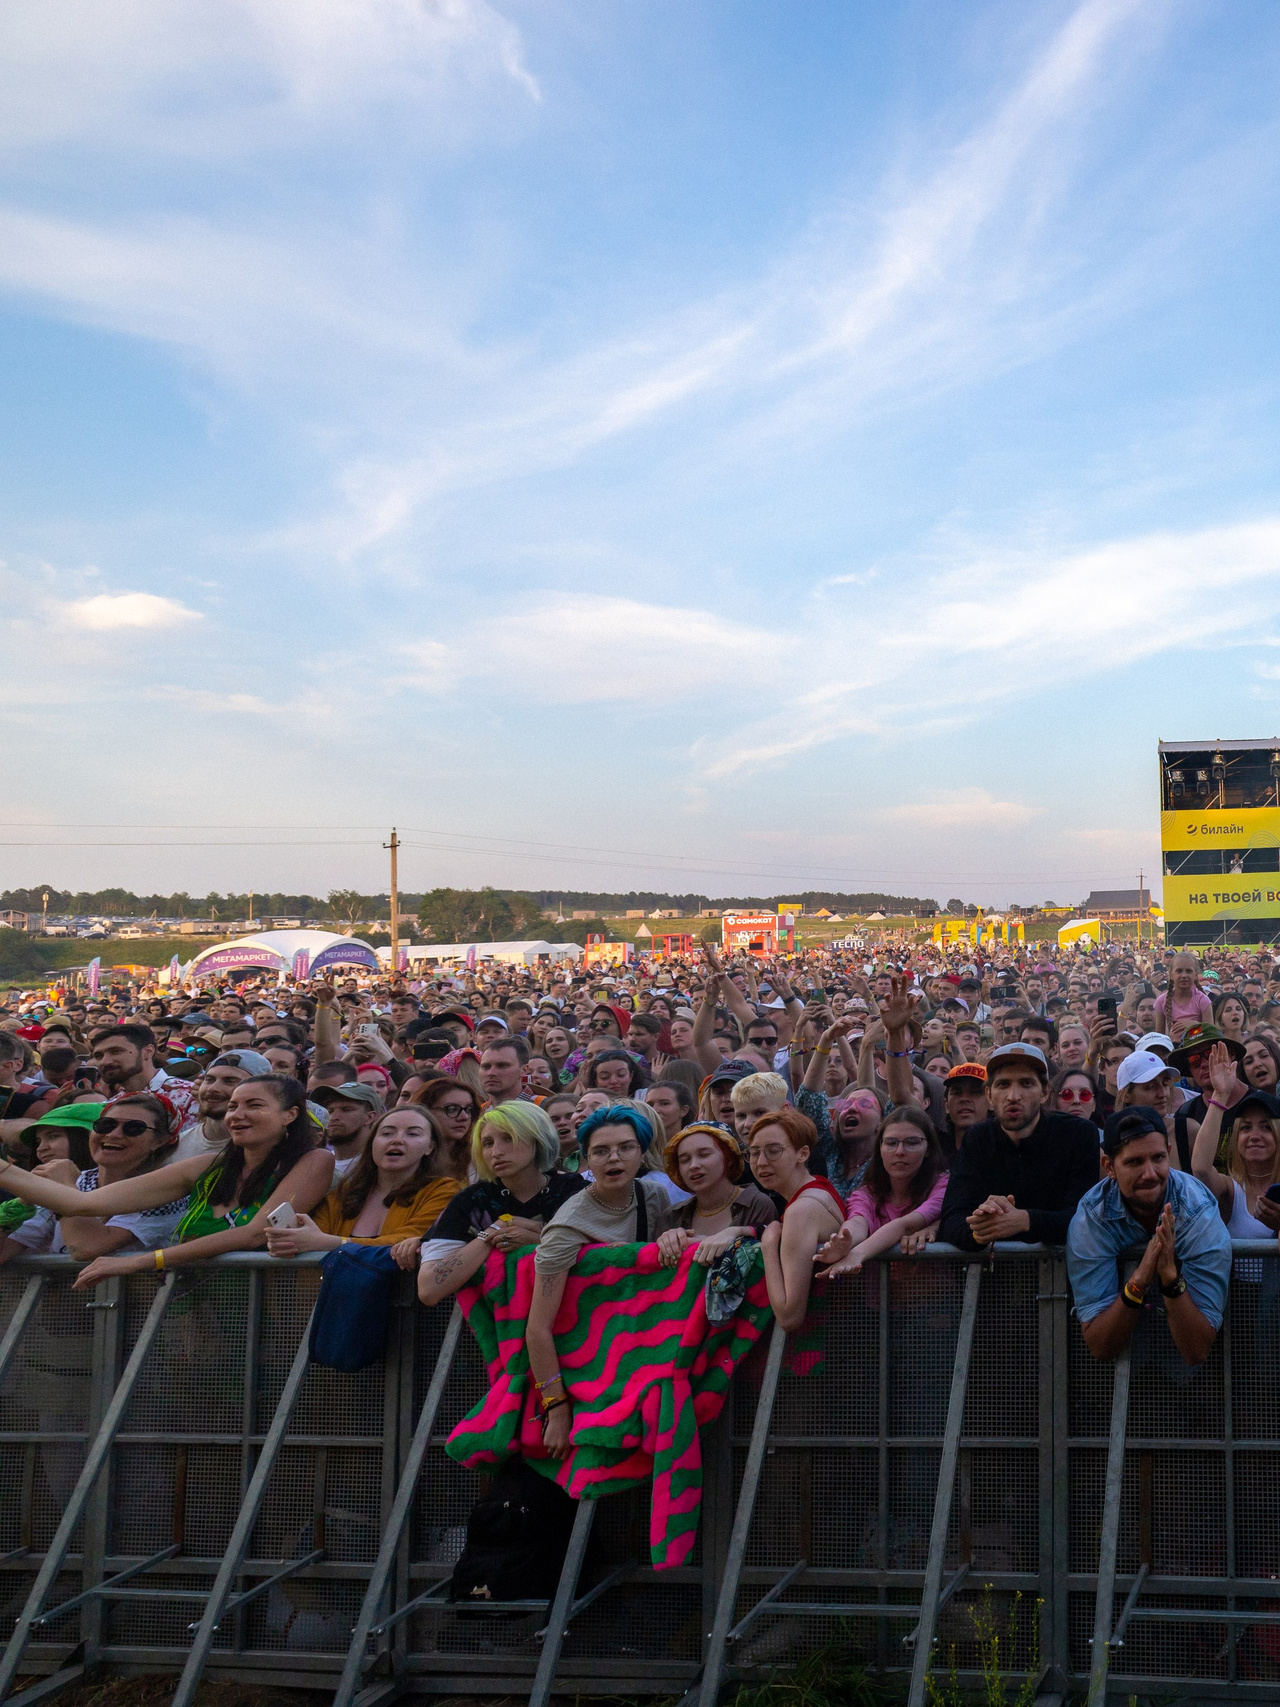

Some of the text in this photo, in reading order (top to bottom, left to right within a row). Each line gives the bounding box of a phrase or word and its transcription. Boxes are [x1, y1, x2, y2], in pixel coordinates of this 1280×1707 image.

[1200, 824, 1243, 835] билайн
[1189, 893, 1208, 904] на
[1213, 888, 1261, 903] твоей
[832, 940, 864, 949] TECNO
[212, 953, 272, 964] МЕГАМАРКЕТ
[324, 950, 366, 959] МЕГАМАРКЕТ
[957, 1066, 985, 1078] OBEY
